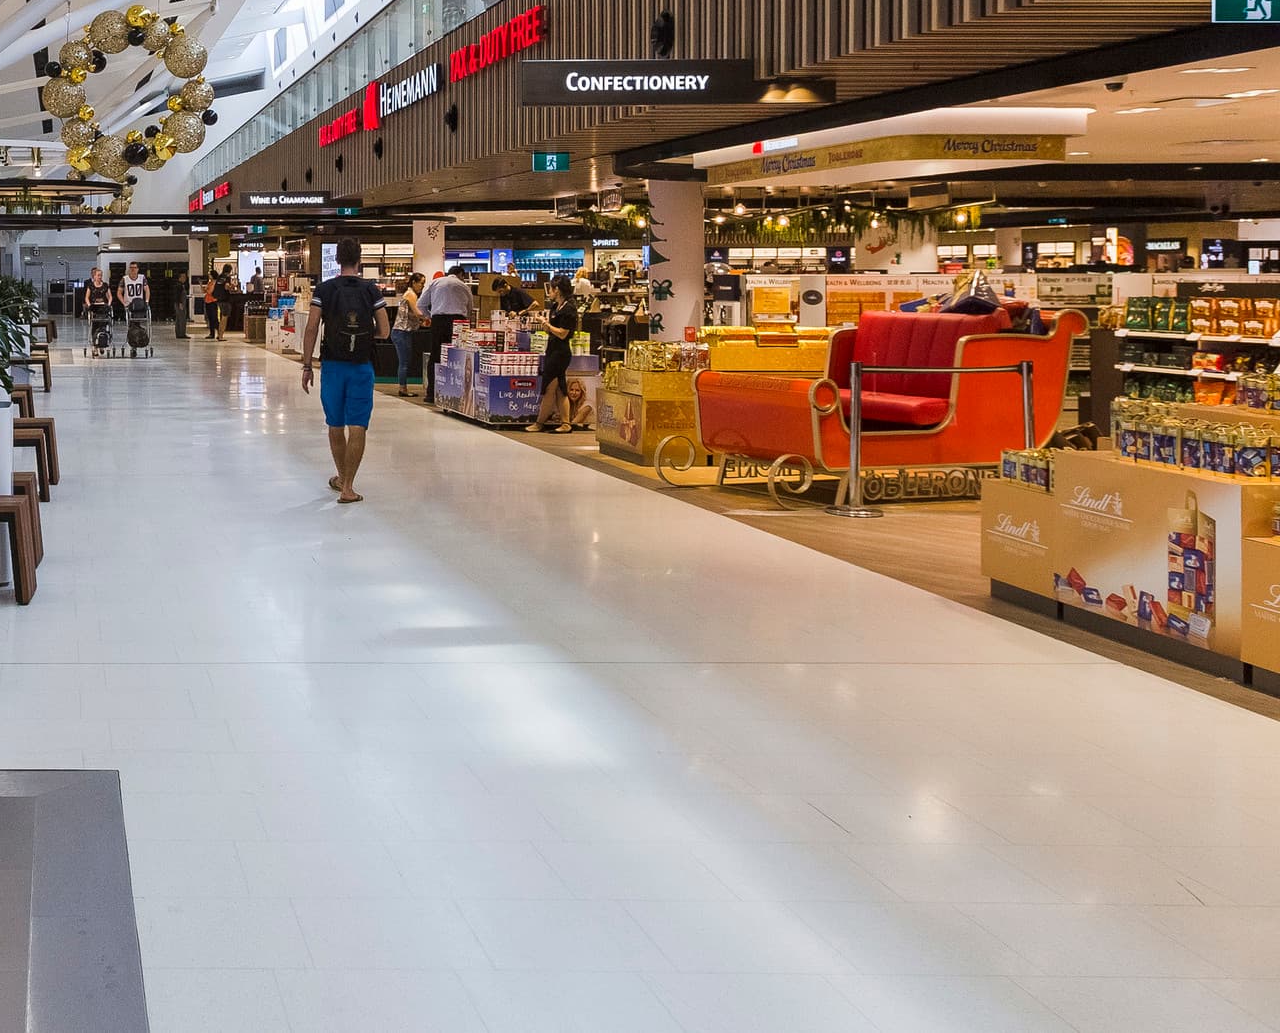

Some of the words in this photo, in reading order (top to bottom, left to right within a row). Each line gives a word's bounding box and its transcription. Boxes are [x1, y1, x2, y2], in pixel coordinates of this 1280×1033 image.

[450, 46, 468, 83] TAX
[469, 44, 479, 74] &
[479, 23, 510, 68] DUTY
[510, 6, 542, 55] FREE
[380, 63, 438, 119] HEINEMANN
[566, 72, 709, 91] CONFECTIONERY
[944, 138, 979, 154] Merry
[981, 139, 1038, 153] Christmas
[250, 196, 270, 204] WINE
[279, 195, 324, 204] CHAMPAGNE
[1071, 485, 1112, 512] Lindt
[995, 513, 1031, 539] Lindt
